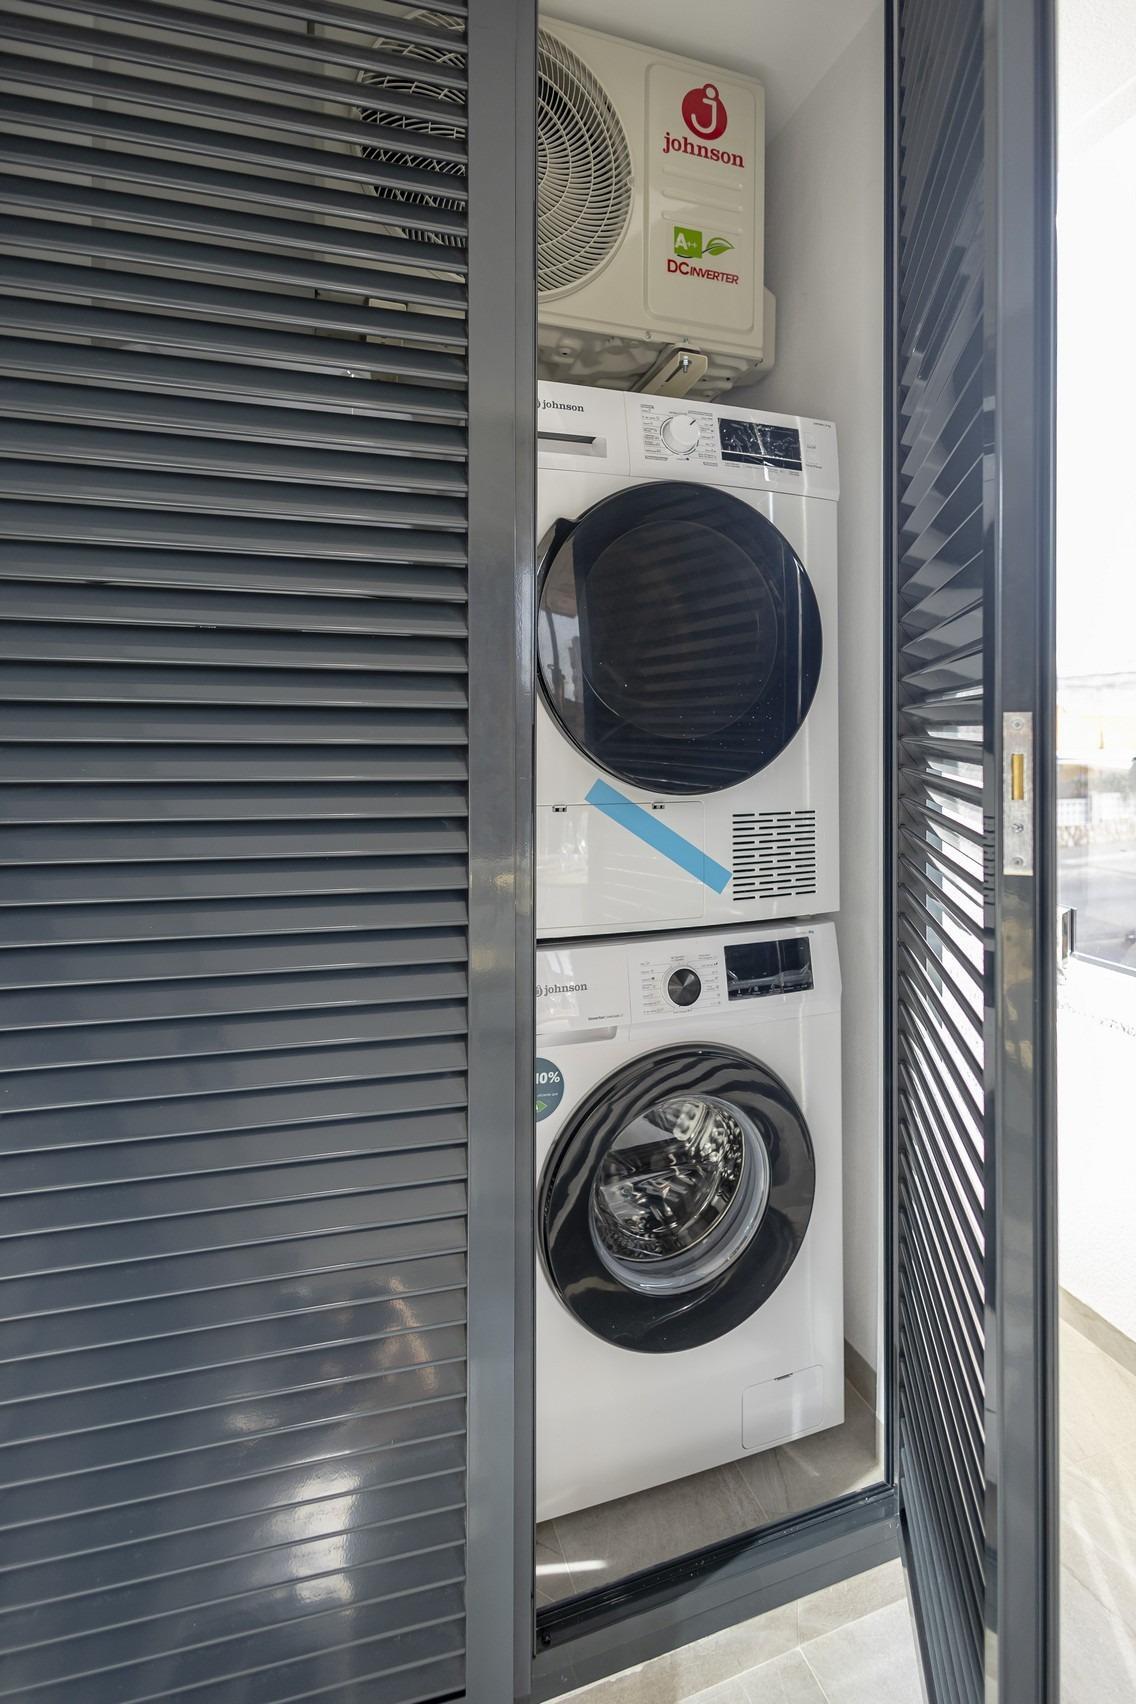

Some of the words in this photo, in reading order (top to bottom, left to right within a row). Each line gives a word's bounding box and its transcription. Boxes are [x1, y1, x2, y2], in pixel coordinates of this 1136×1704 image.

[662, 132, 745, 168] johnson
[542, 400, 584, 412] johnson
[543, 983, 588, 997] johnson
